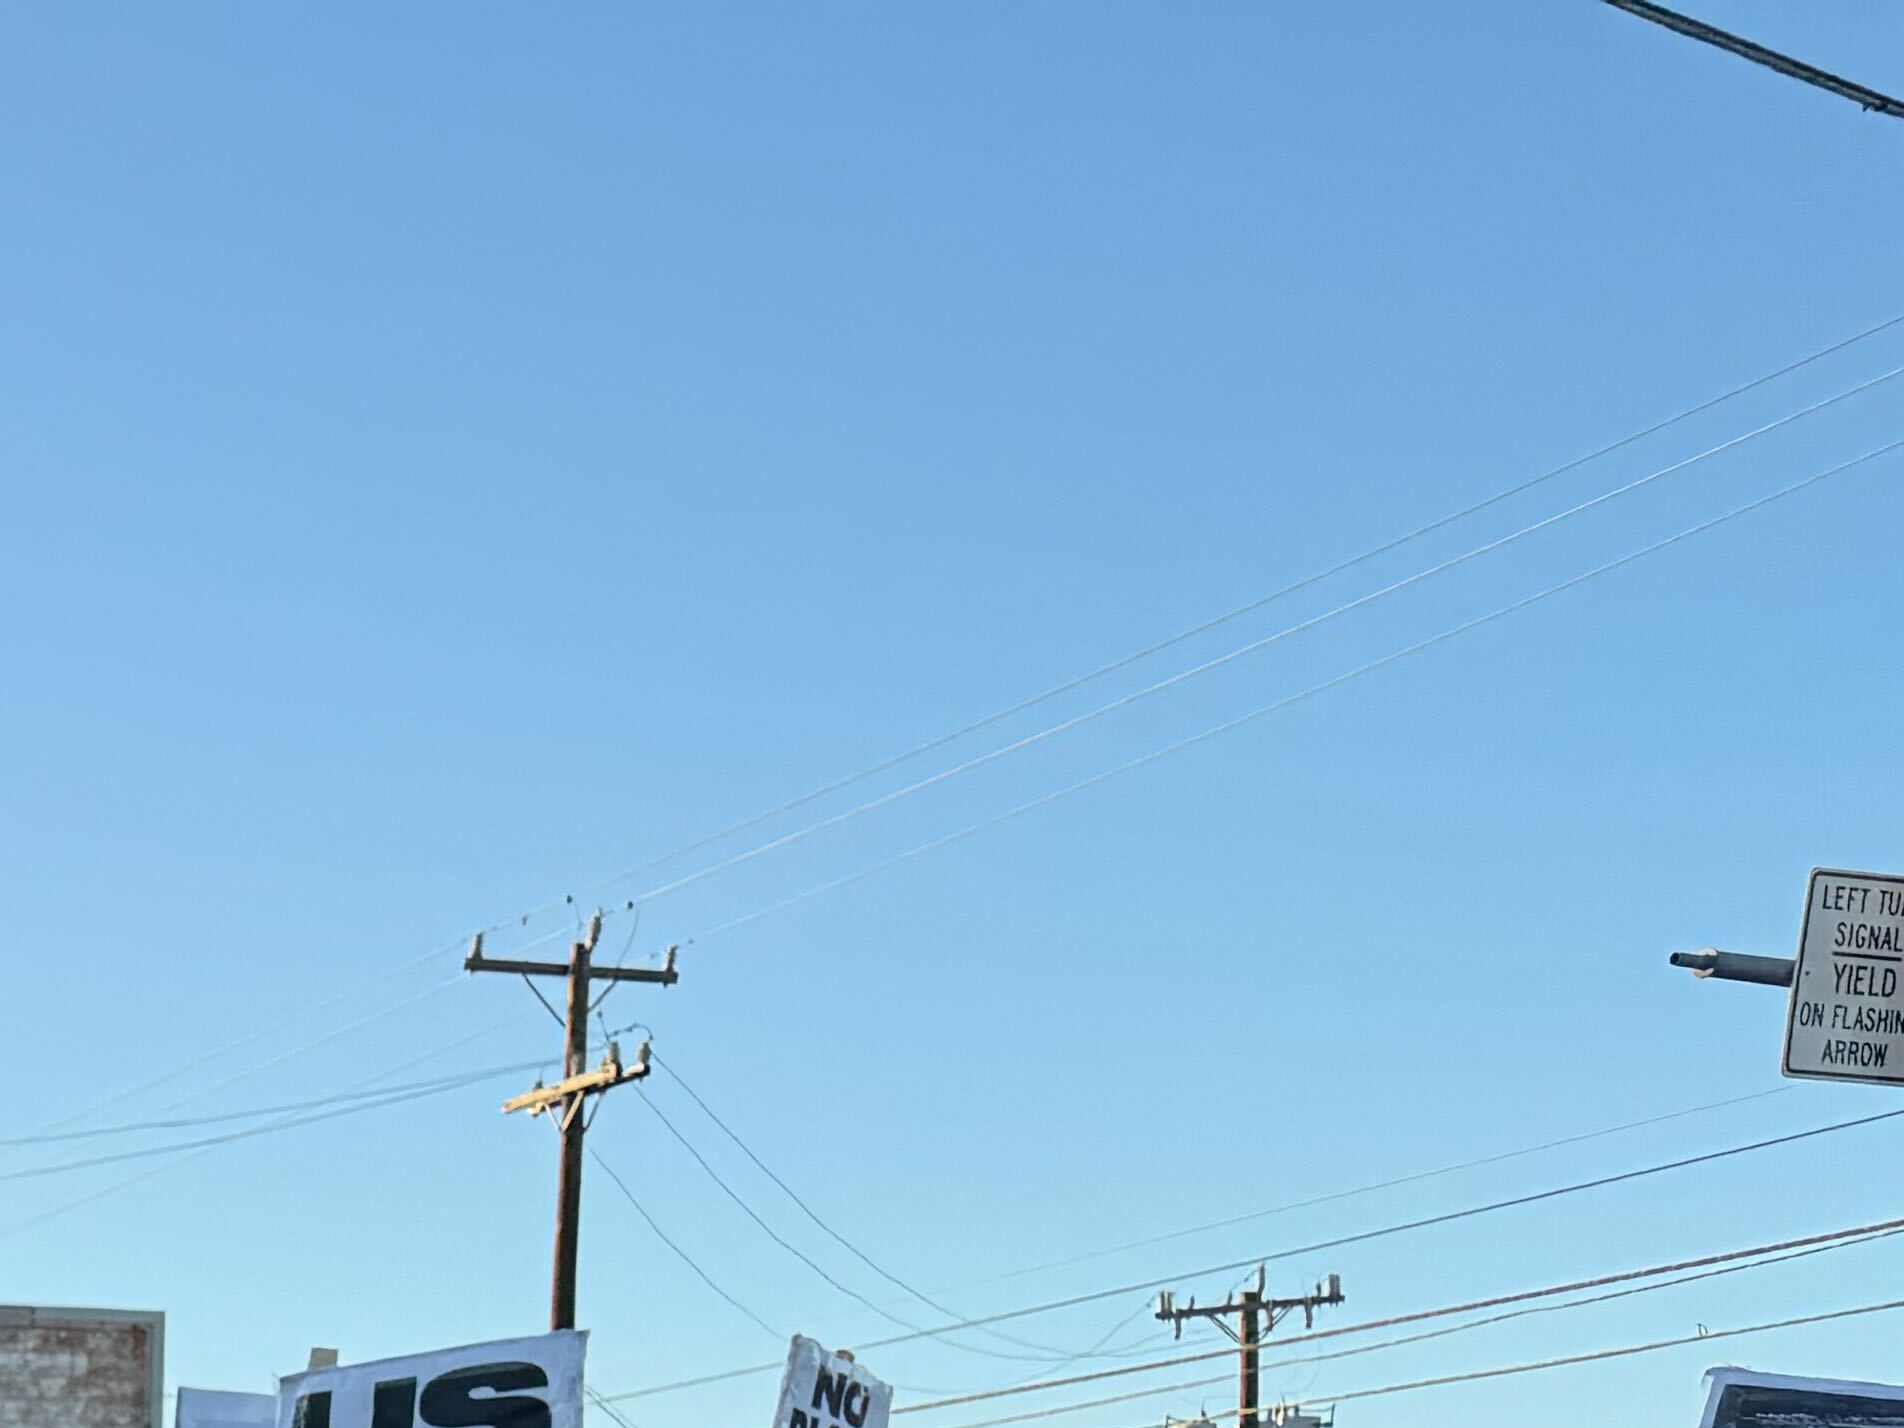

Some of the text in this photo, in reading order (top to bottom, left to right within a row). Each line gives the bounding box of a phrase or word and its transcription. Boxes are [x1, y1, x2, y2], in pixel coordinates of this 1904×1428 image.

[1822, 885, 1904, 917] LEFT TU
[1835, 921, 1903, 952] SIGNAL
[1833, 963, 1897, 998] YIELD
[1799, 1001, 1825, 1027] ON
[1821, 1039, 1889, 1068] ARROW
[811, 1365, 872, 1428] NO
